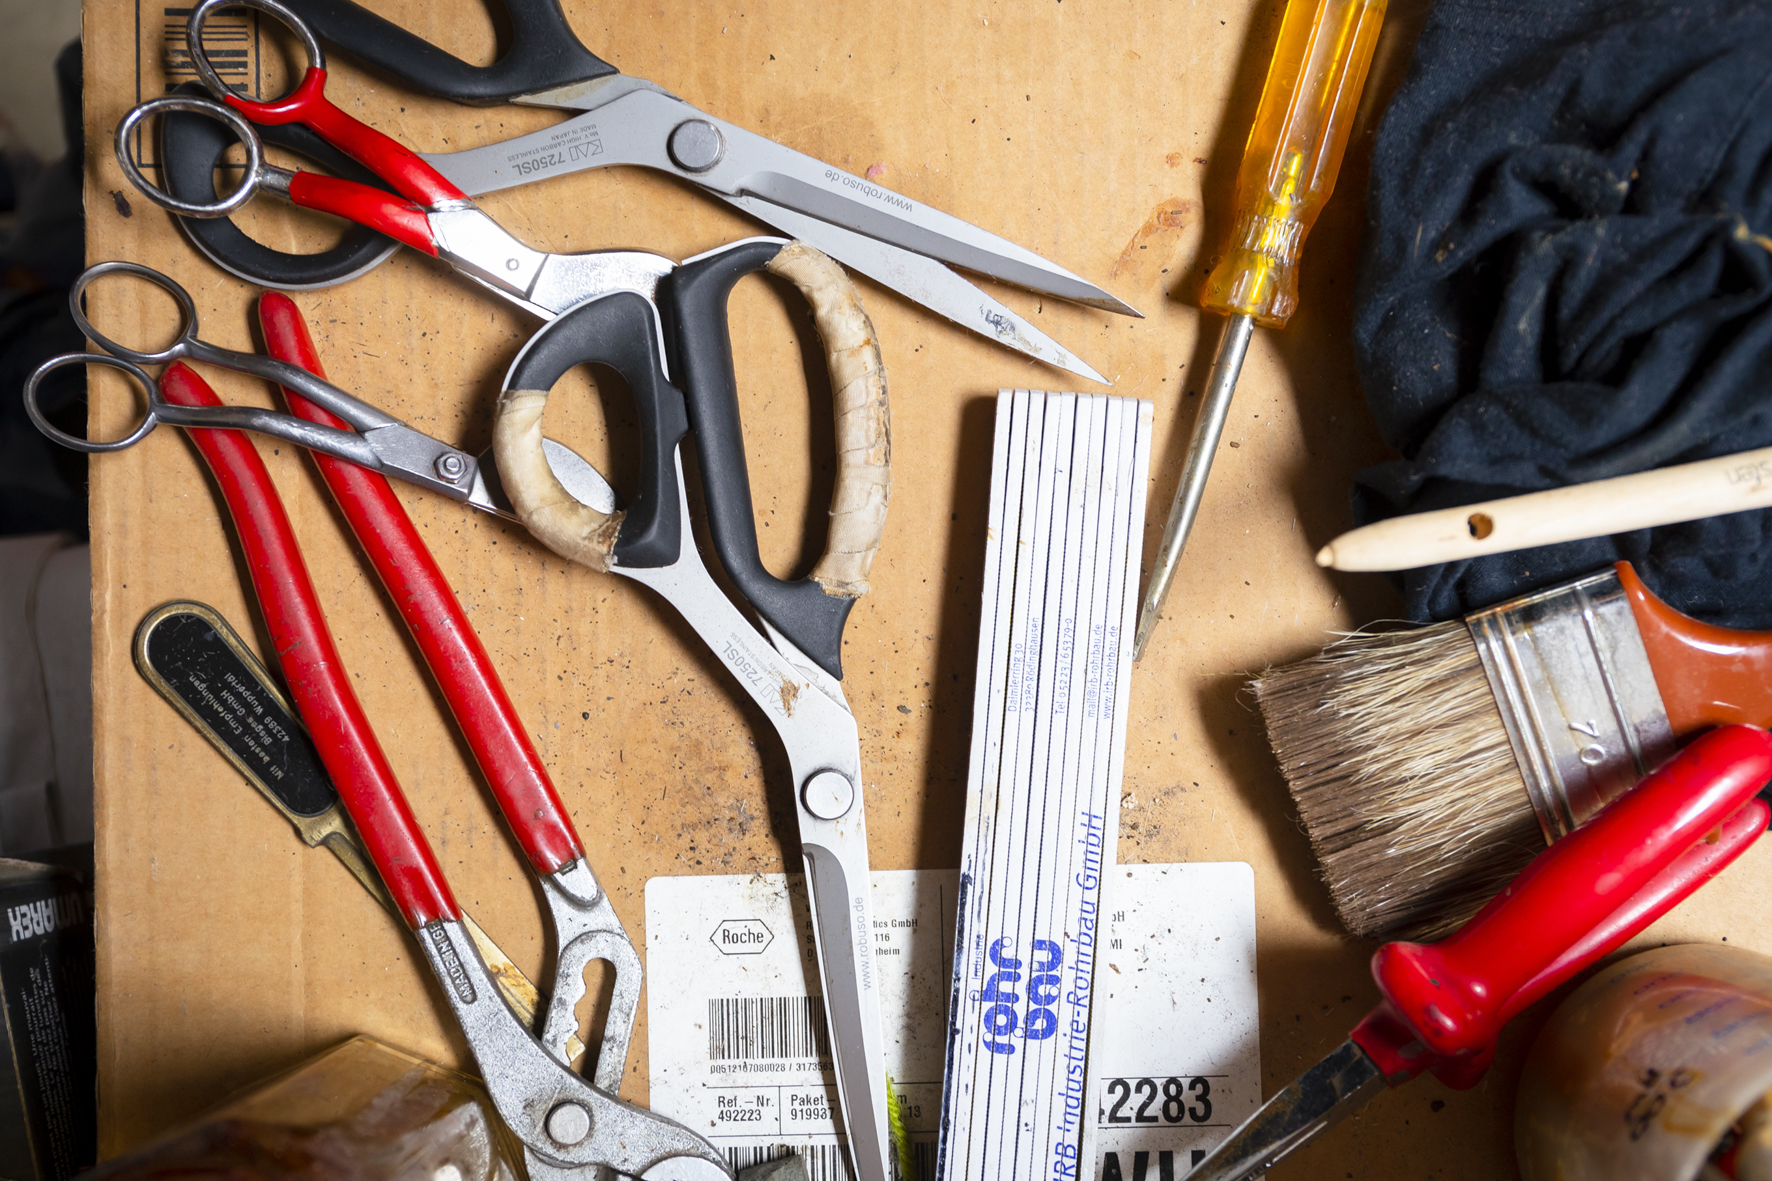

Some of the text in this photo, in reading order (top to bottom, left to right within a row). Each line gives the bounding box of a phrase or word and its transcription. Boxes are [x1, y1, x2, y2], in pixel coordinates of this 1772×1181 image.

[551, 131, 571, 141] JAPAN
[566, 136, 582, 145] HIGH
[580, 124, 597, 133] MADE
[507, 147, 540, 162] STAINLESS
[540, 141, 566, 152] CARBON
[512, 152, 566, 175] 7250SL
[825, 170, 913, 212] www.robuso.de
[731, 632, 756, 659] STAINLESS
[723, 640, 763, 686] 7250SL
[755, 659, 774, 680] CARBON
[1102, 626, 1118, 719] www.irb-rohrbau.de
[1008, 657, 1023, 712] Daimlerring
[221, 690, 245, 716] GmbH
[264, 716, 290, 742] 42389
[244, 735, 270, 764] besten
[270, 764, 285, 780] Mit
[7, 895, 84, 941] UMAREX
[892, 919, 918, 928] GmbH
[438, 941, 453, 957] IN
[722, 928, 764, 945] Roche
[855, 897, 871, 990] www.robuso.de
[972, 933, 984, 980] Industrie
[29, 966, 36, 982] de
[445, 957, 473, 997] MADE
[1056, 900, 1096, 1132] Industrie-Rohrbau
[1076, 811, 1103, 891] GmbH
[43, 980, 50, 996] Ne
[969, 935, 1023, 1055] rohr
[1013, 937, 1063, 1041] bau
[33, 982, 43, 1027] lunettes
[30, 996, 41, 1042] pourrait
[30, 1033, 39, 1056] Une
[1098, 1076, 1212, 1123] 2283
[718, 1109, 762, 1121] 492223
